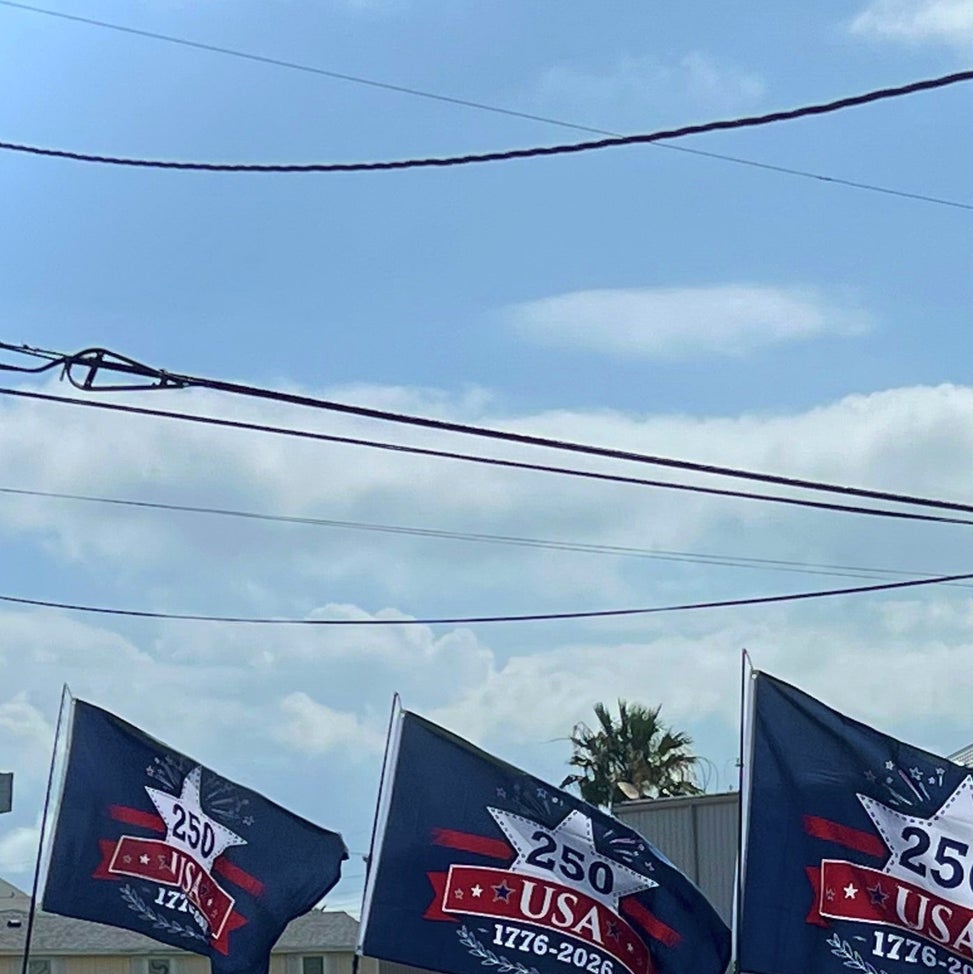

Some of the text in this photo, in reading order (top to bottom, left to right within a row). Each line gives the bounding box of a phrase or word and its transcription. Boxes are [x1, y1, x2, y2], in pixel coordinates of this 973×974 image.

[171, 804, 215, 859] 250
[525, 831, 614, 895] 250
[518, 879, 604, 945] USA
